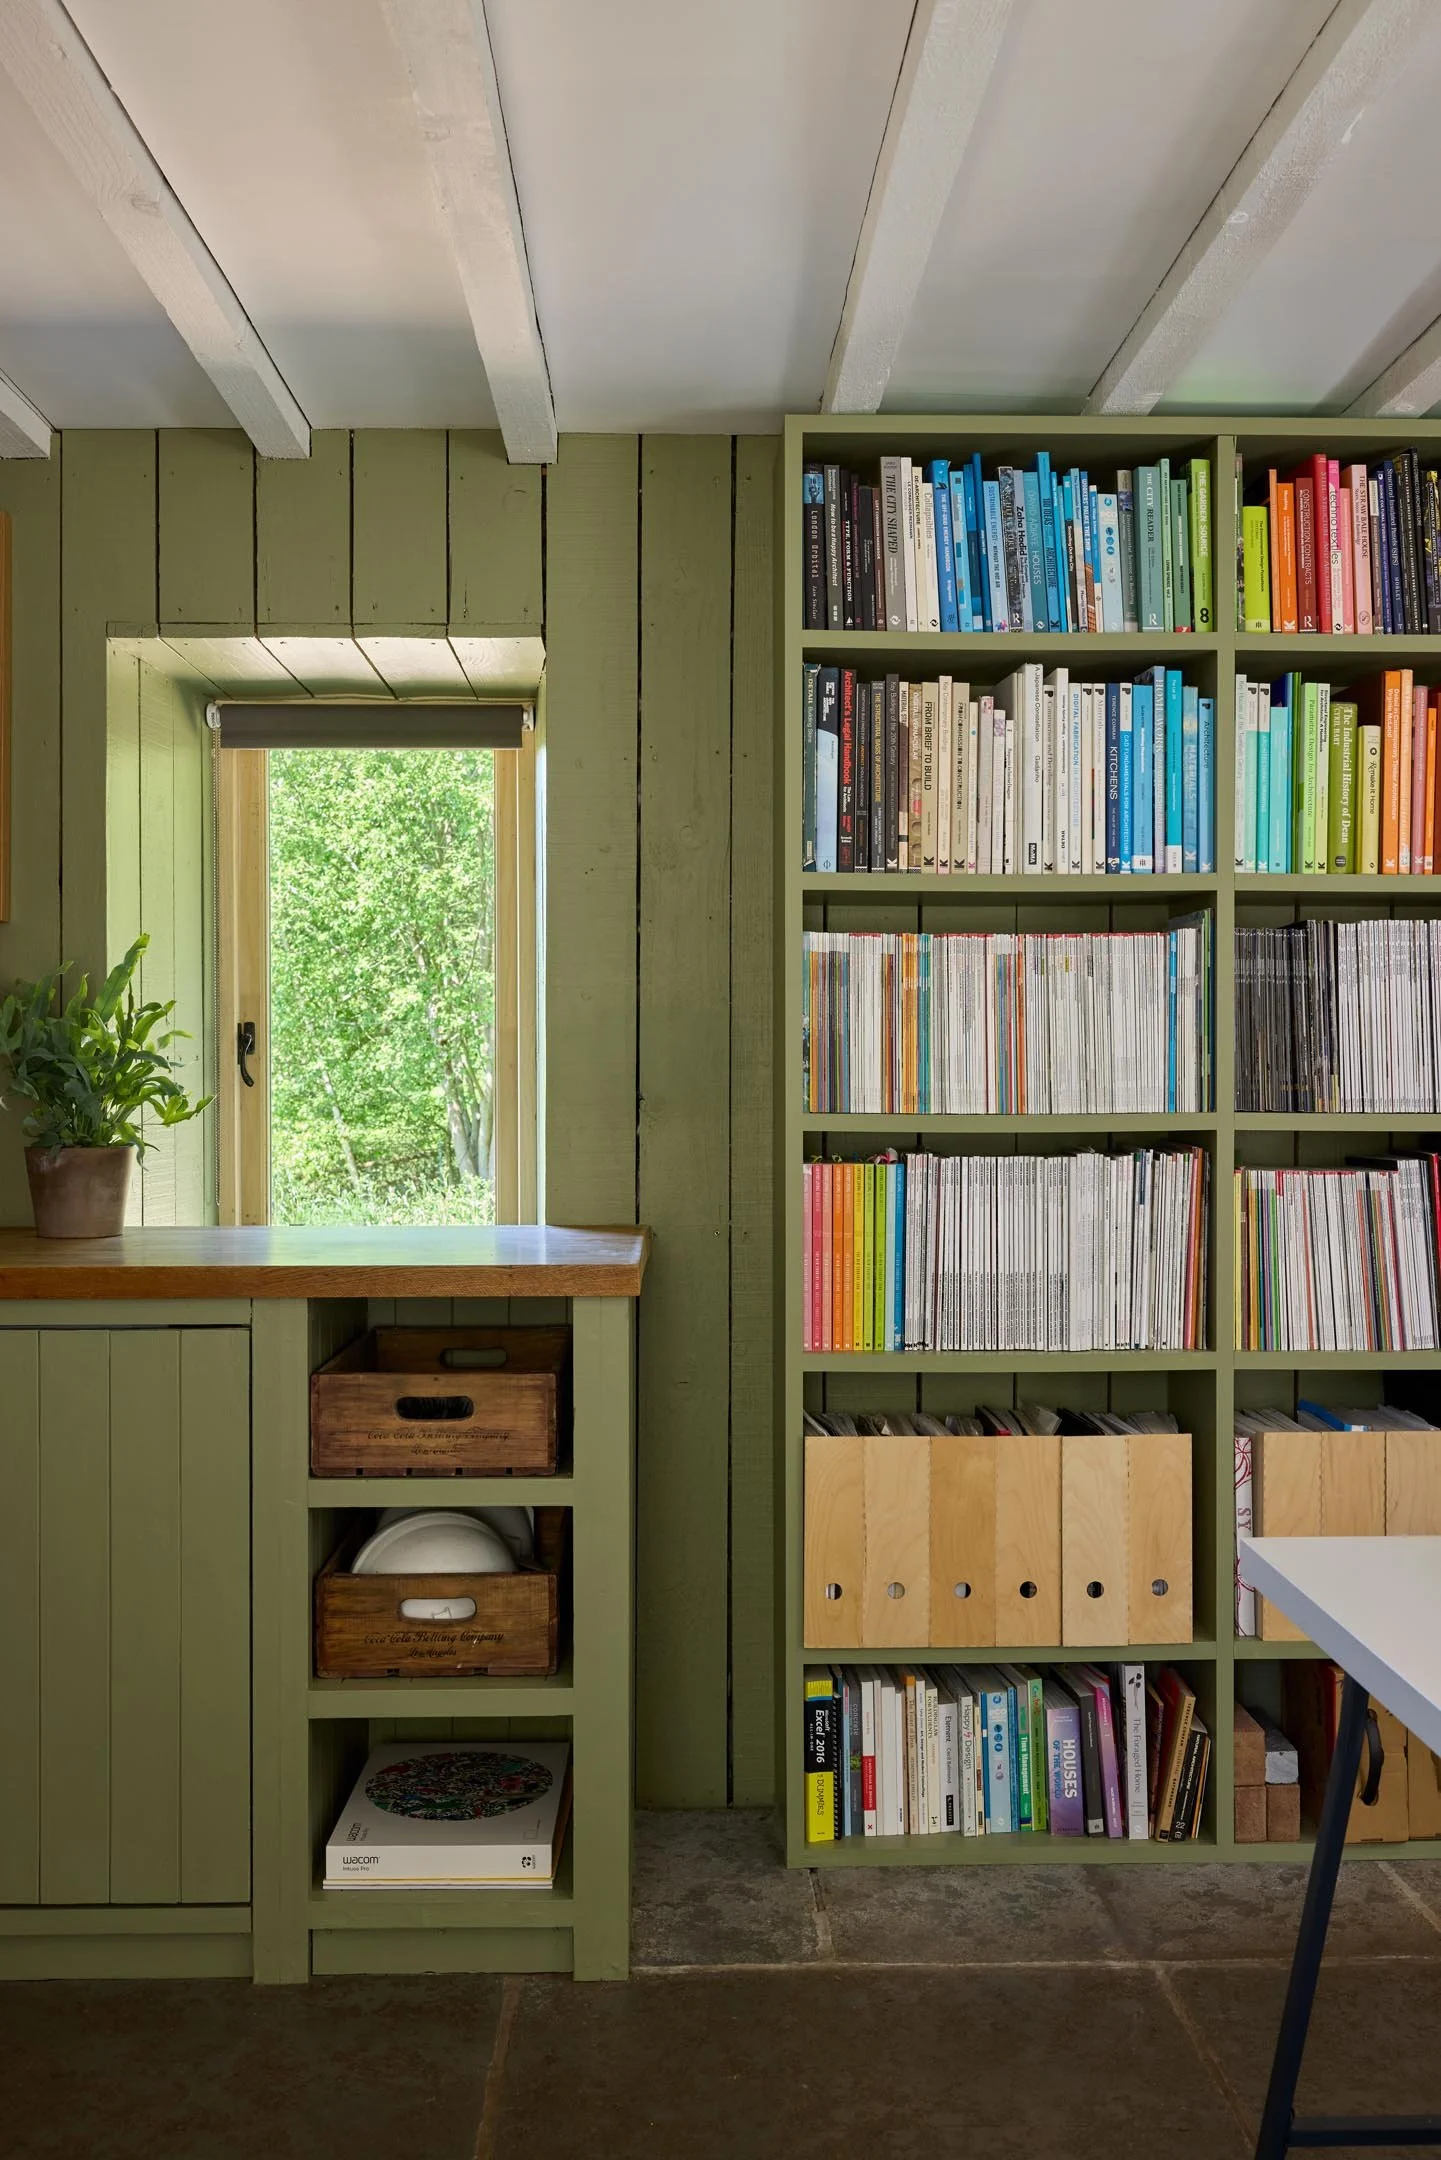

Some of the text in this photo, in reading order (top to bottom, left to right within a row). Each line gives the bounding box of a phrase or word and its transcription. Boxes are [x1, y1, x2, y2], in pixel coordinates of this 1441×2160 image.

[886, 474, 896, 492] THE
[886, 494, 897, 515] CITY
[830, 524, 837, 533] be
[887, 518, 898, 554] SHAPED
[924, 492, 933, 539] Collapsibles
[1016, 506, 1027, 556] Zaha Hadid
[1302, 489, 1312, 584] CONSTRUCTION CONTRACTS
[1330, 491, 1341, 564] techno textiles
[1386, 469, 1399, 566] Structural Insulated Panels (SIPS)
[1032, 550, 1041, 584] HOUSES
[1045, 547, 1057, 588] ARCHITECTURE
[843, 671, 852, 785] Architect's Legal Handbook
[1156, 680, 1164, 753] HOME WORK
[924, 701, 933, 790] FROM BRIEF TO BUILD
[1110, 746, 1118, 800] KITCHENS
[1188, 745, 1196, 800] MATERIALS
[1340, 708, 1353, 844] The Industrial History of Dean
[1368, 761, 1377, 788] Remake
[413, 1631, 457, 1645] Bottling
[460, 1630, 504, 1643] Company
[1184, 1702, 1192, 1724] TERENCE
[816, 1709, 825, 1763] Excel 2016
[1053, 1740, 1061, 1752] OF
[1132, 1718, 1142, 1792] The Foraged Home
[1179, 1726, 1187, 1747] CONRAN
[1020, 1754, 1029, 1794] Management
[1062, 1739, 1078, 1798] HOUSES
[1186, 1734, 1201, 1790] NATURAL ARCHITECTURE
[816, 1779, 825, 1816] DUMMIES
[1054, 1771, 1062, 1799] WORLD
[347, 1823, 361, 1841] wacom
